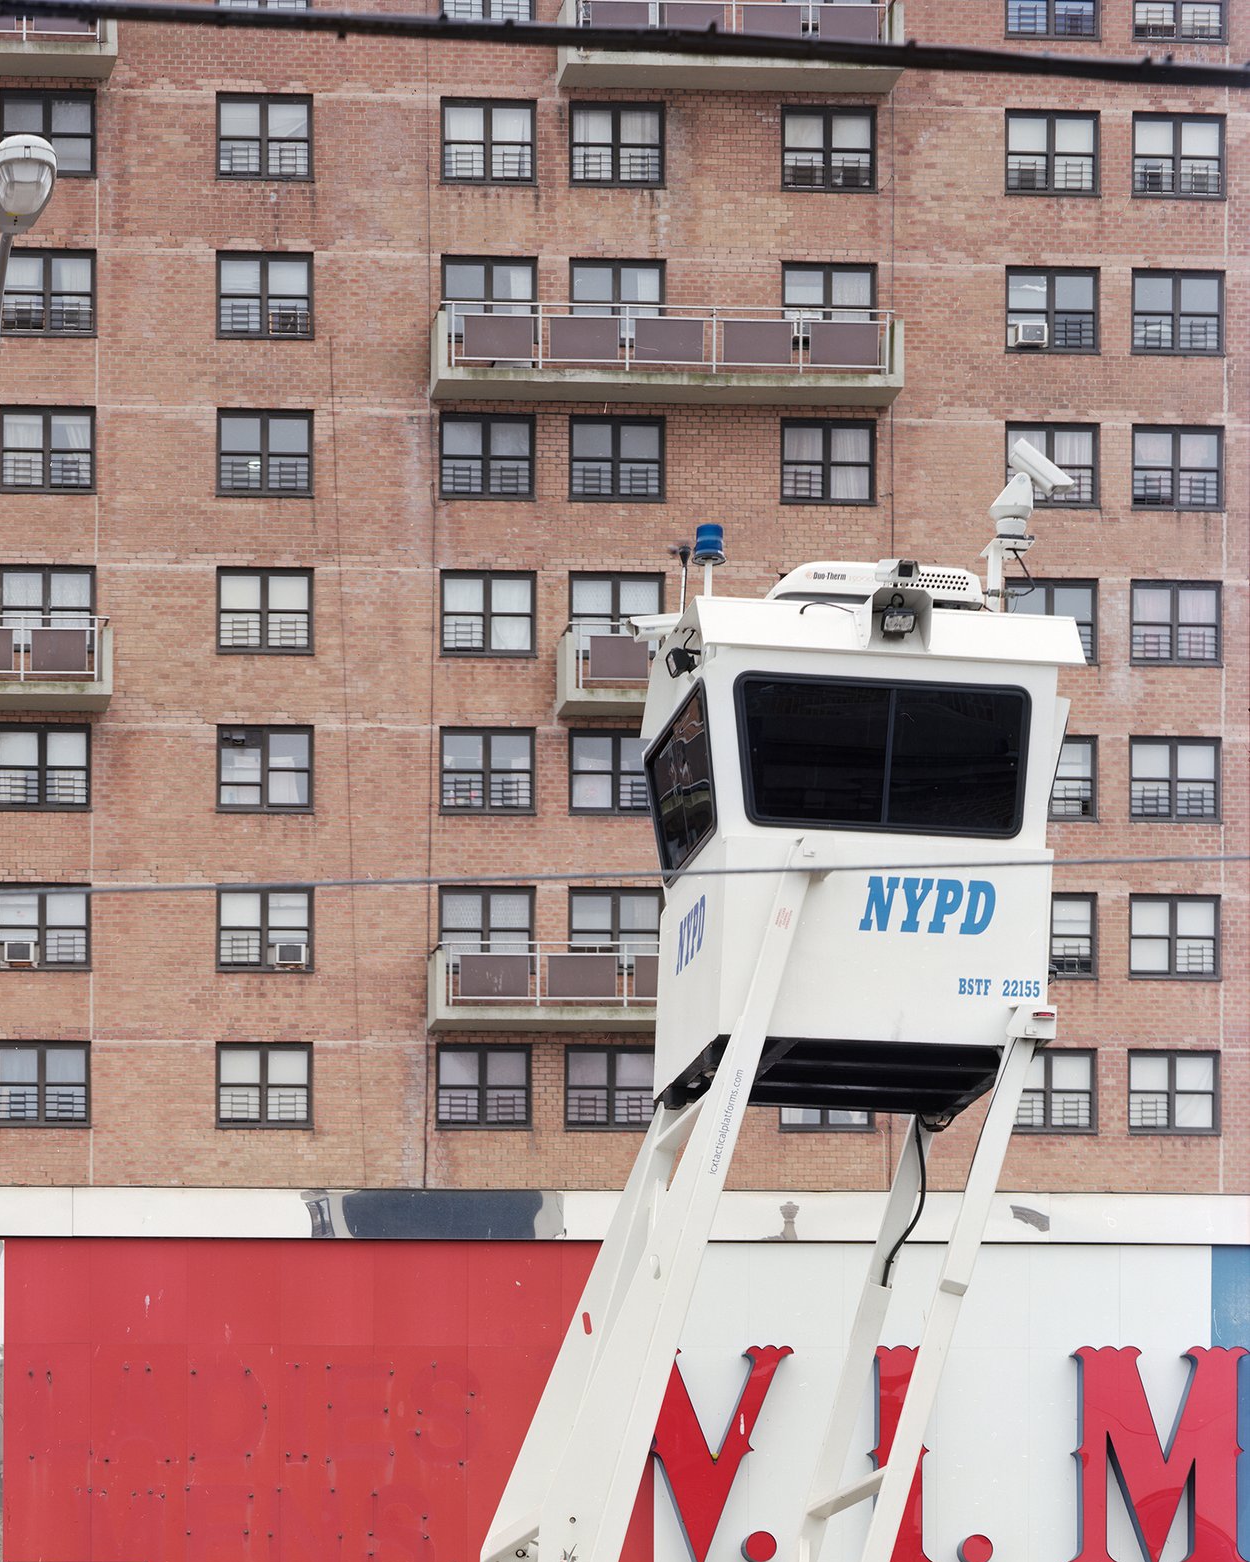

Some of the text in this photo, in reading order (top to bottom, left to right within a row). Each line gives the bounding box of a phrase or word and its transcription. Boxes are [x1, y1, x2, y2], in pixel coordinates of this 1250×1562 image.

[675, 894, 706, 977] NYPD
[859, 876, 997, 936] NYPD
[958, 978, 1041, 998] BSTF 22155
[709, 1069, 744, 1176] icxtacticalplatforms.com
